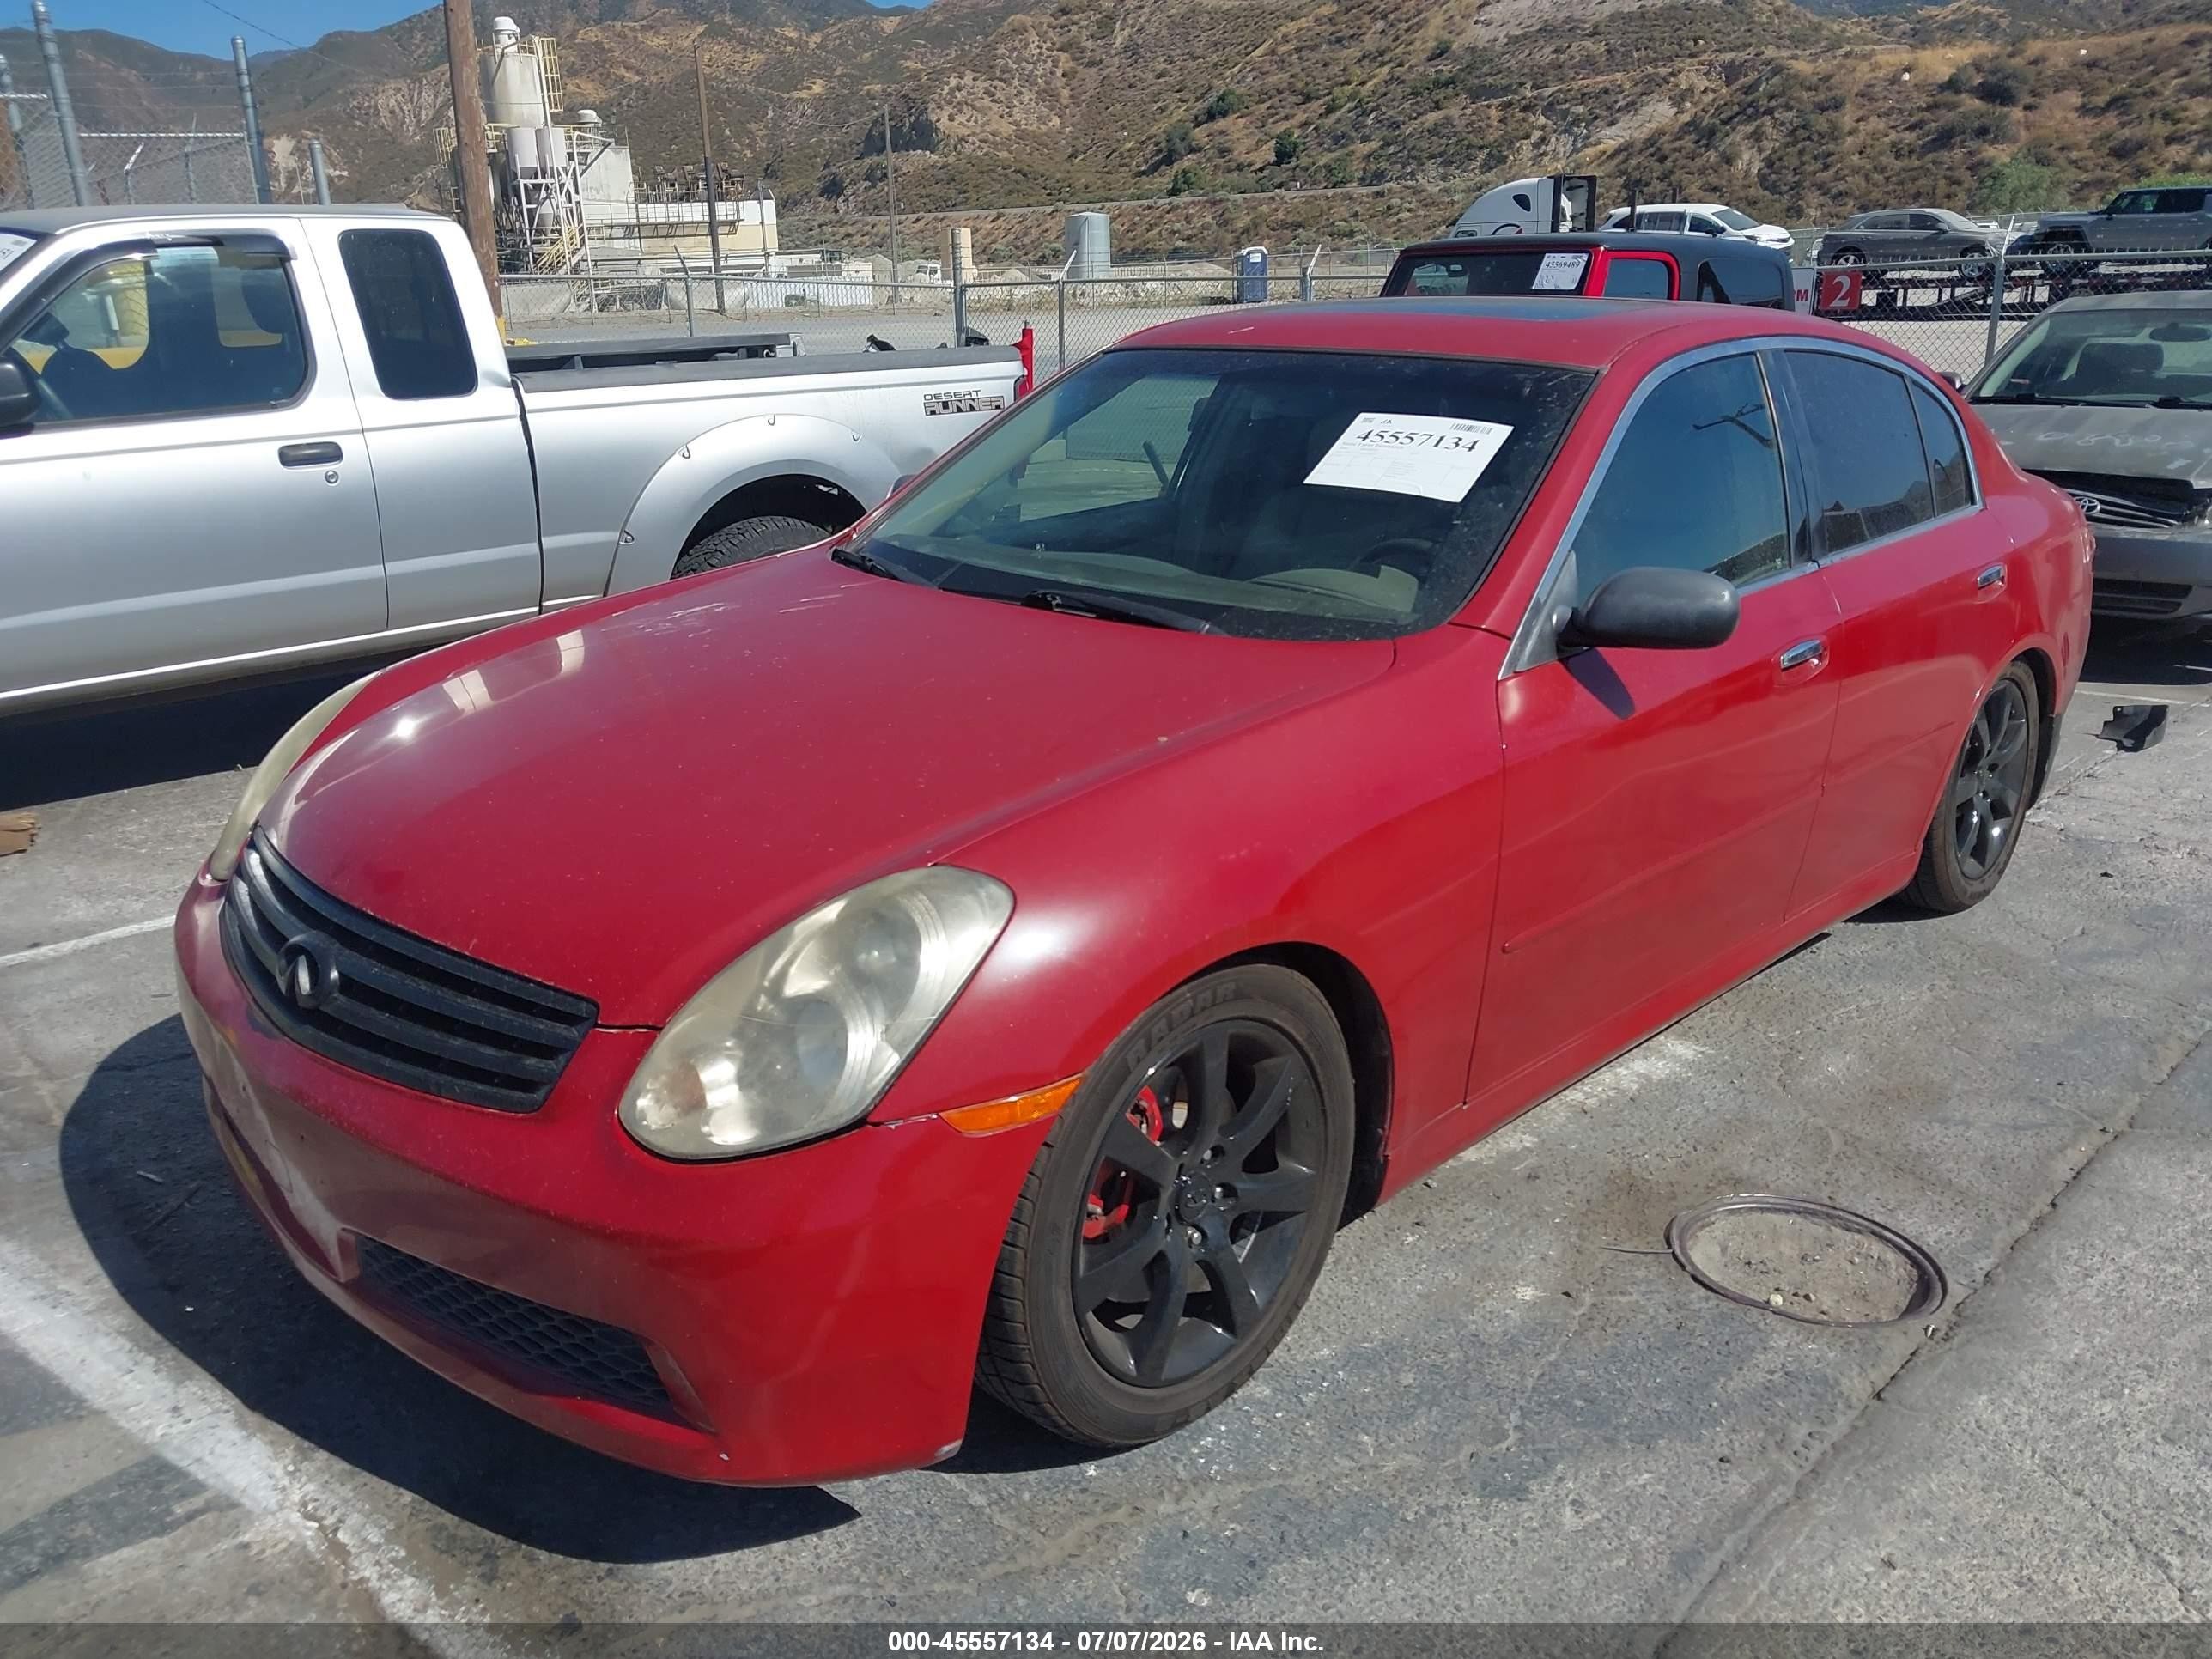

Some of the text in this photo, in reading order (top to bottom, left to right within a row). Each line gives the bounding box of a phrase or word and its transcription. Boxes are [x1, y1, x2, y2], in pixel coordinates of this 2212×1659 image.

[1545, 260, 1581, 269] 45569489
[1829, 275, 1851, 307] 2
[923, 389, 981, 401] DESERT
[924, 396, 1005, 416] RUNNER
[1356, 428, 1480, 453] 45557134
